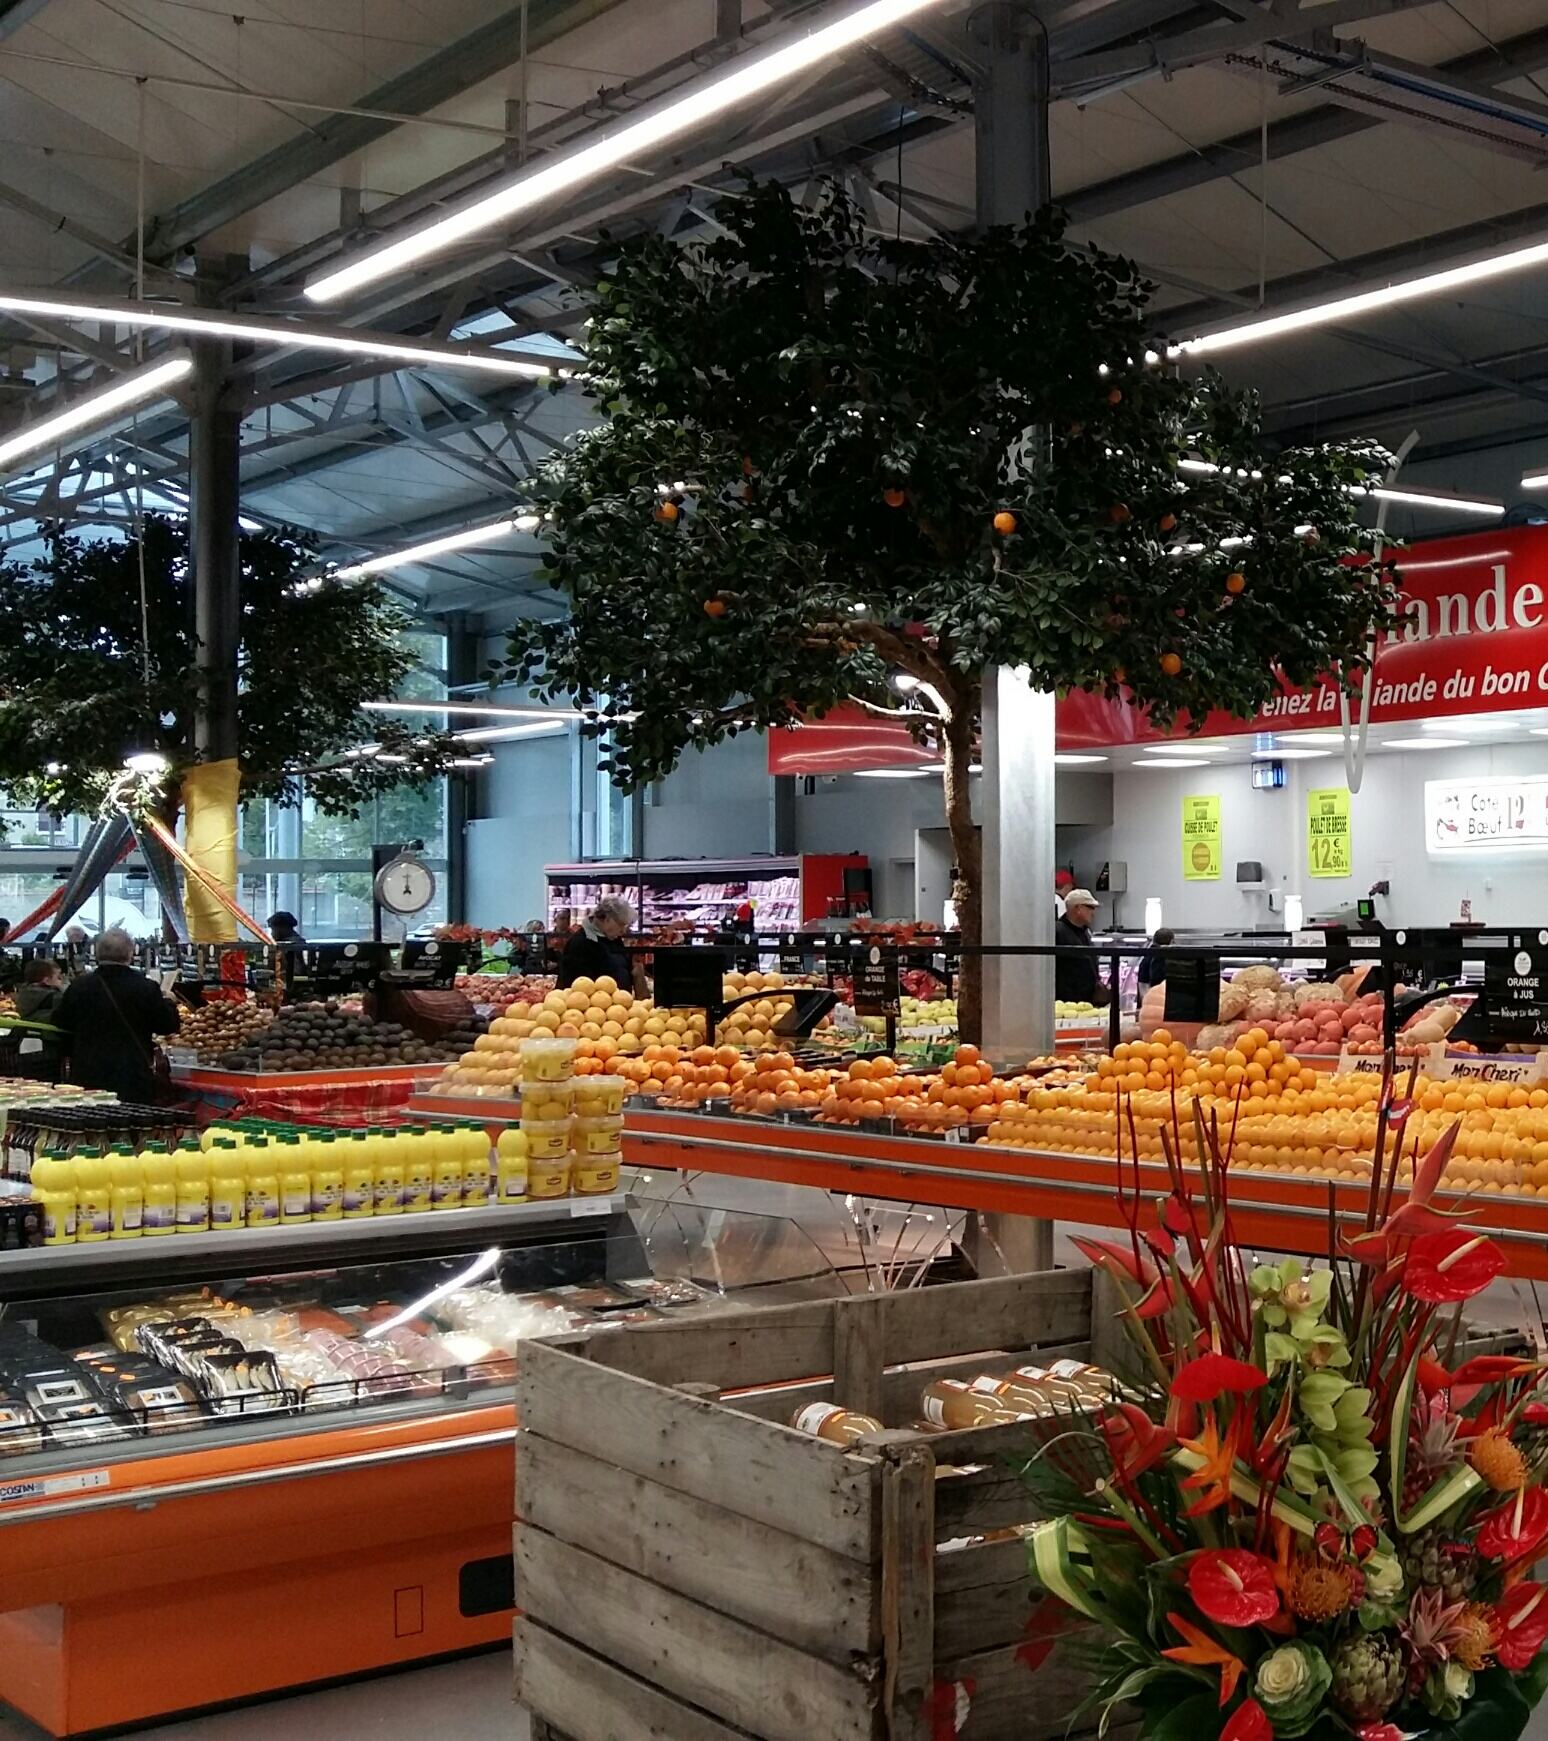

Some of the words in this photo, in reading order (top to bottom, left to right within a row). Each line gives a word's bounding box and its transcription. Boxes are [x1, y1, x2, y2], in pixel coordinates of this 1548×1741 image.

[1380, 565, 1545, 646] iande
[1262, 690, 1311, 717] enez
[1316, 684, 1337, 712] la
[1372, 672, 1435, 706] iande
[1443, 668, 1475, 700] du
[1481, 665, 1531, 695] bon
[1507, 977, 1539, 987] ORANGE
[1519, 989, 1534, 999] JUS
